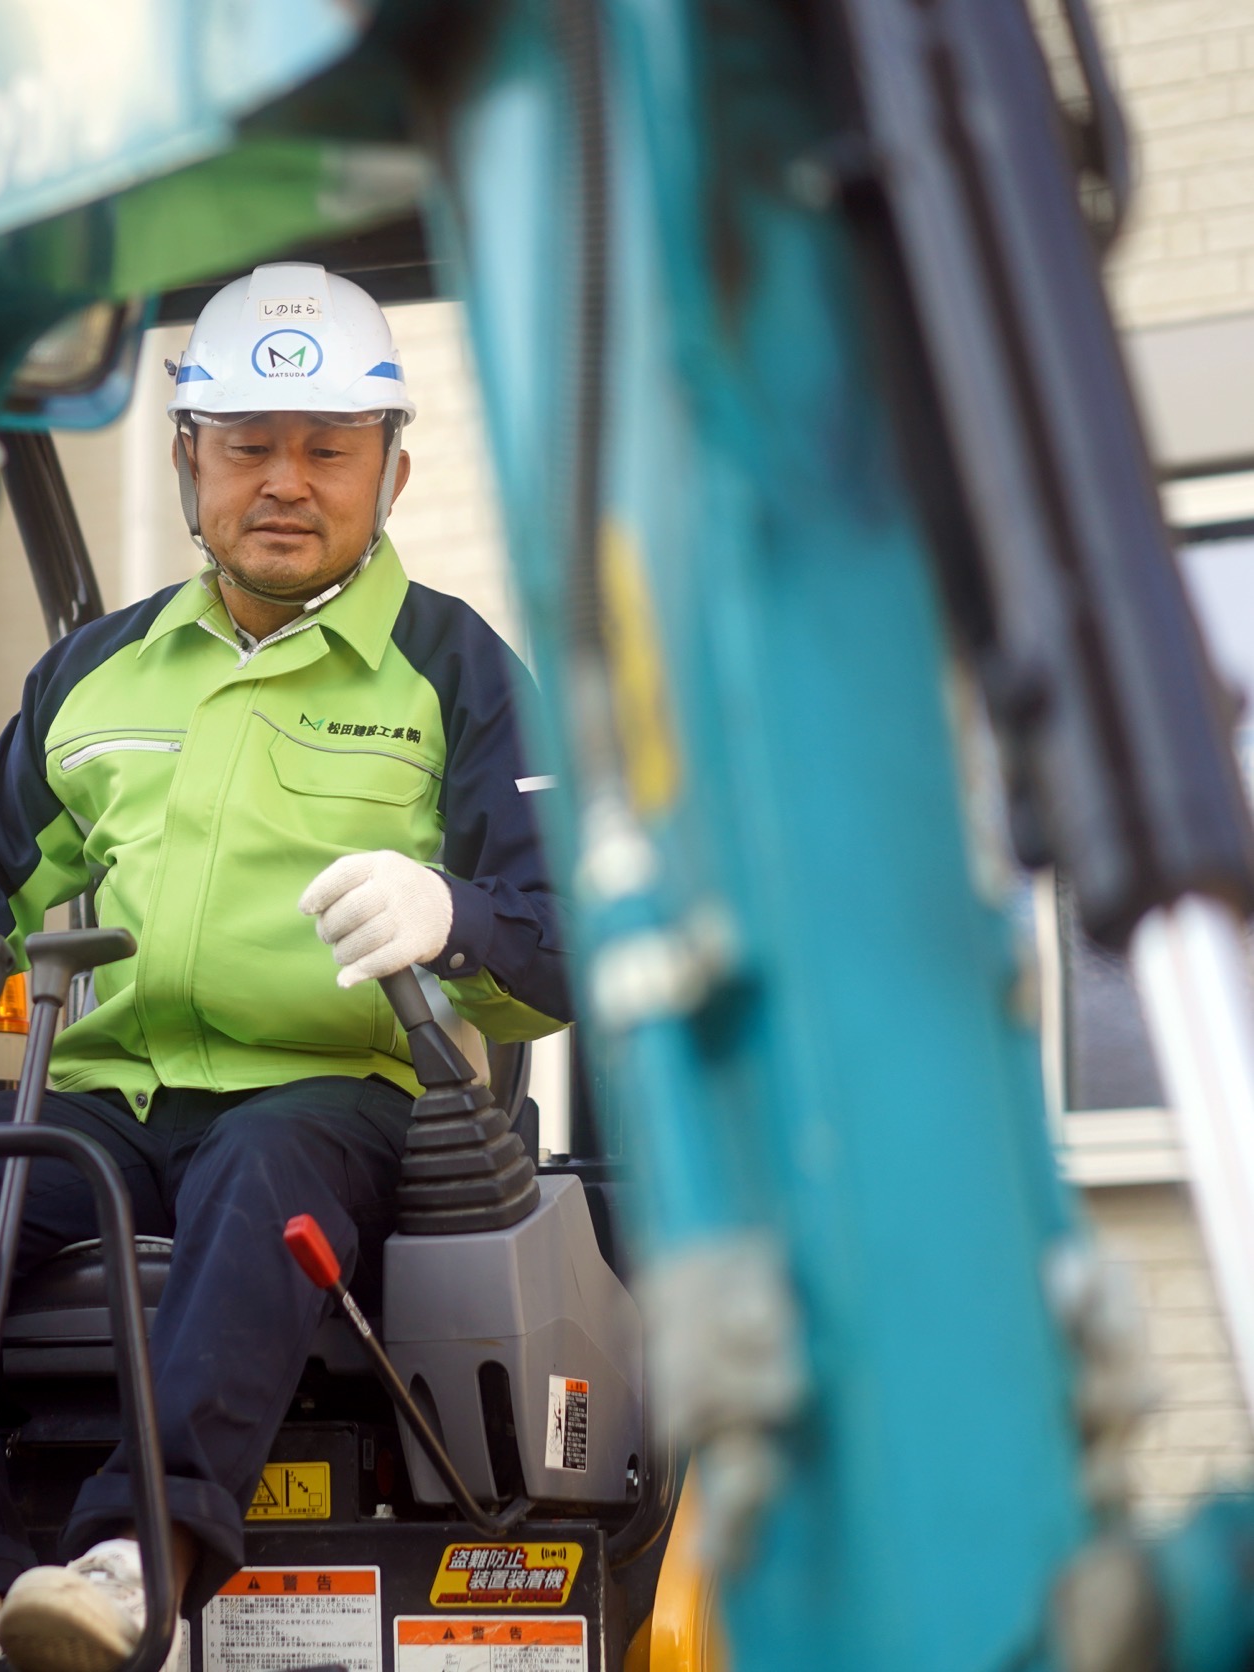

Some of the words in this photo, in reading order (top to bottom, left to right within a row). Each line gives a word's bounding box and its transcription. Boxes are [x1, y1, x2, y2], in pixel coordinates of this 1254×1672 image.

[263, 303, 316, 315] しのはら
[448, 1548, 525, 1569] 盗難防止
[282, 1574, 332, 1591] 警告
[468, 1569, 566, 1590] 装置装着機
